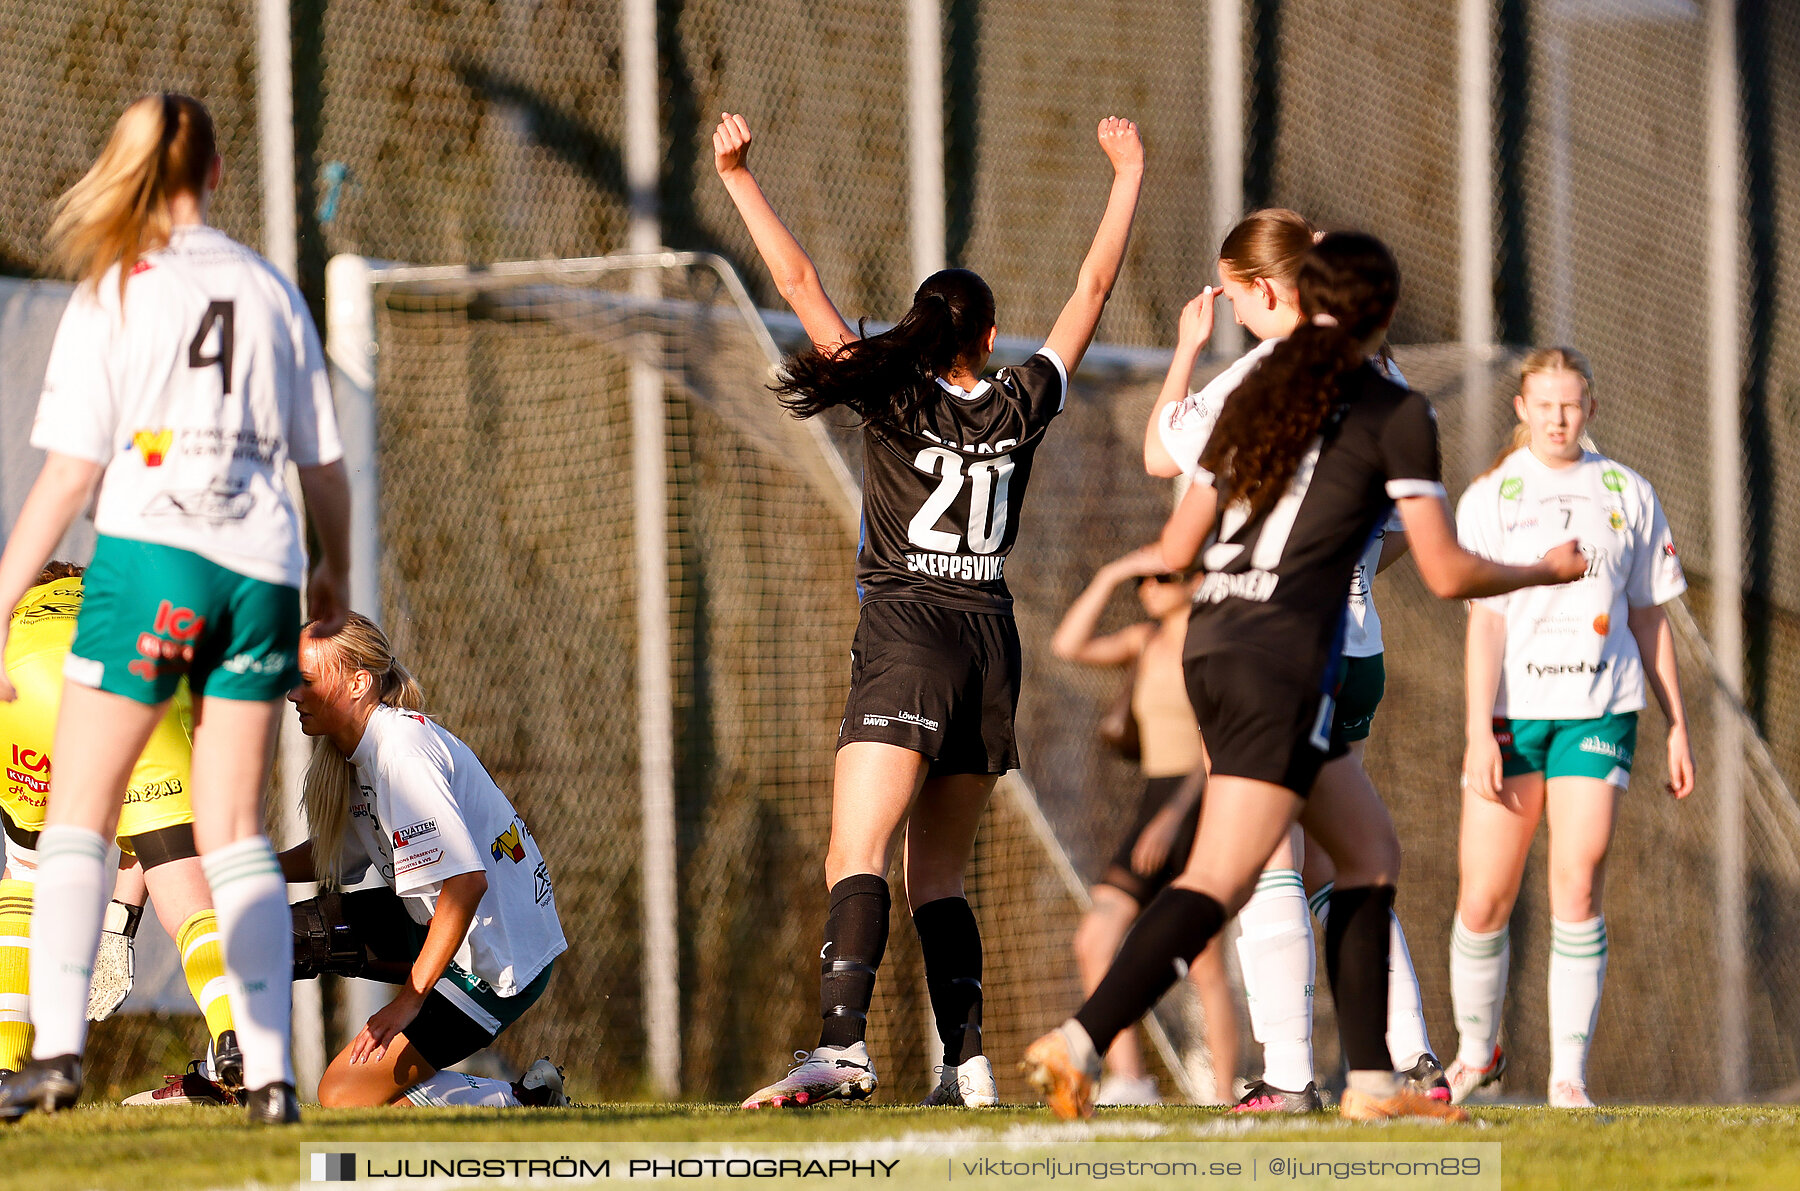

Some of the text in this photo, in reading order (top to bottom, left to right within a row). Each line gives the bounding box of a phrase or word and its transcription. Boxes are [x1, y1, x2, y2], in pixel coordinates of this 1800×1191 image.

[189, 300, 234, 394] 4
[907, 446, 1016, 554] 20
[1560, 508, 1572, 530] 7
[863, 717, 889, 727] DAVID
[400, 820, 435, 837] TVÄTTEN
